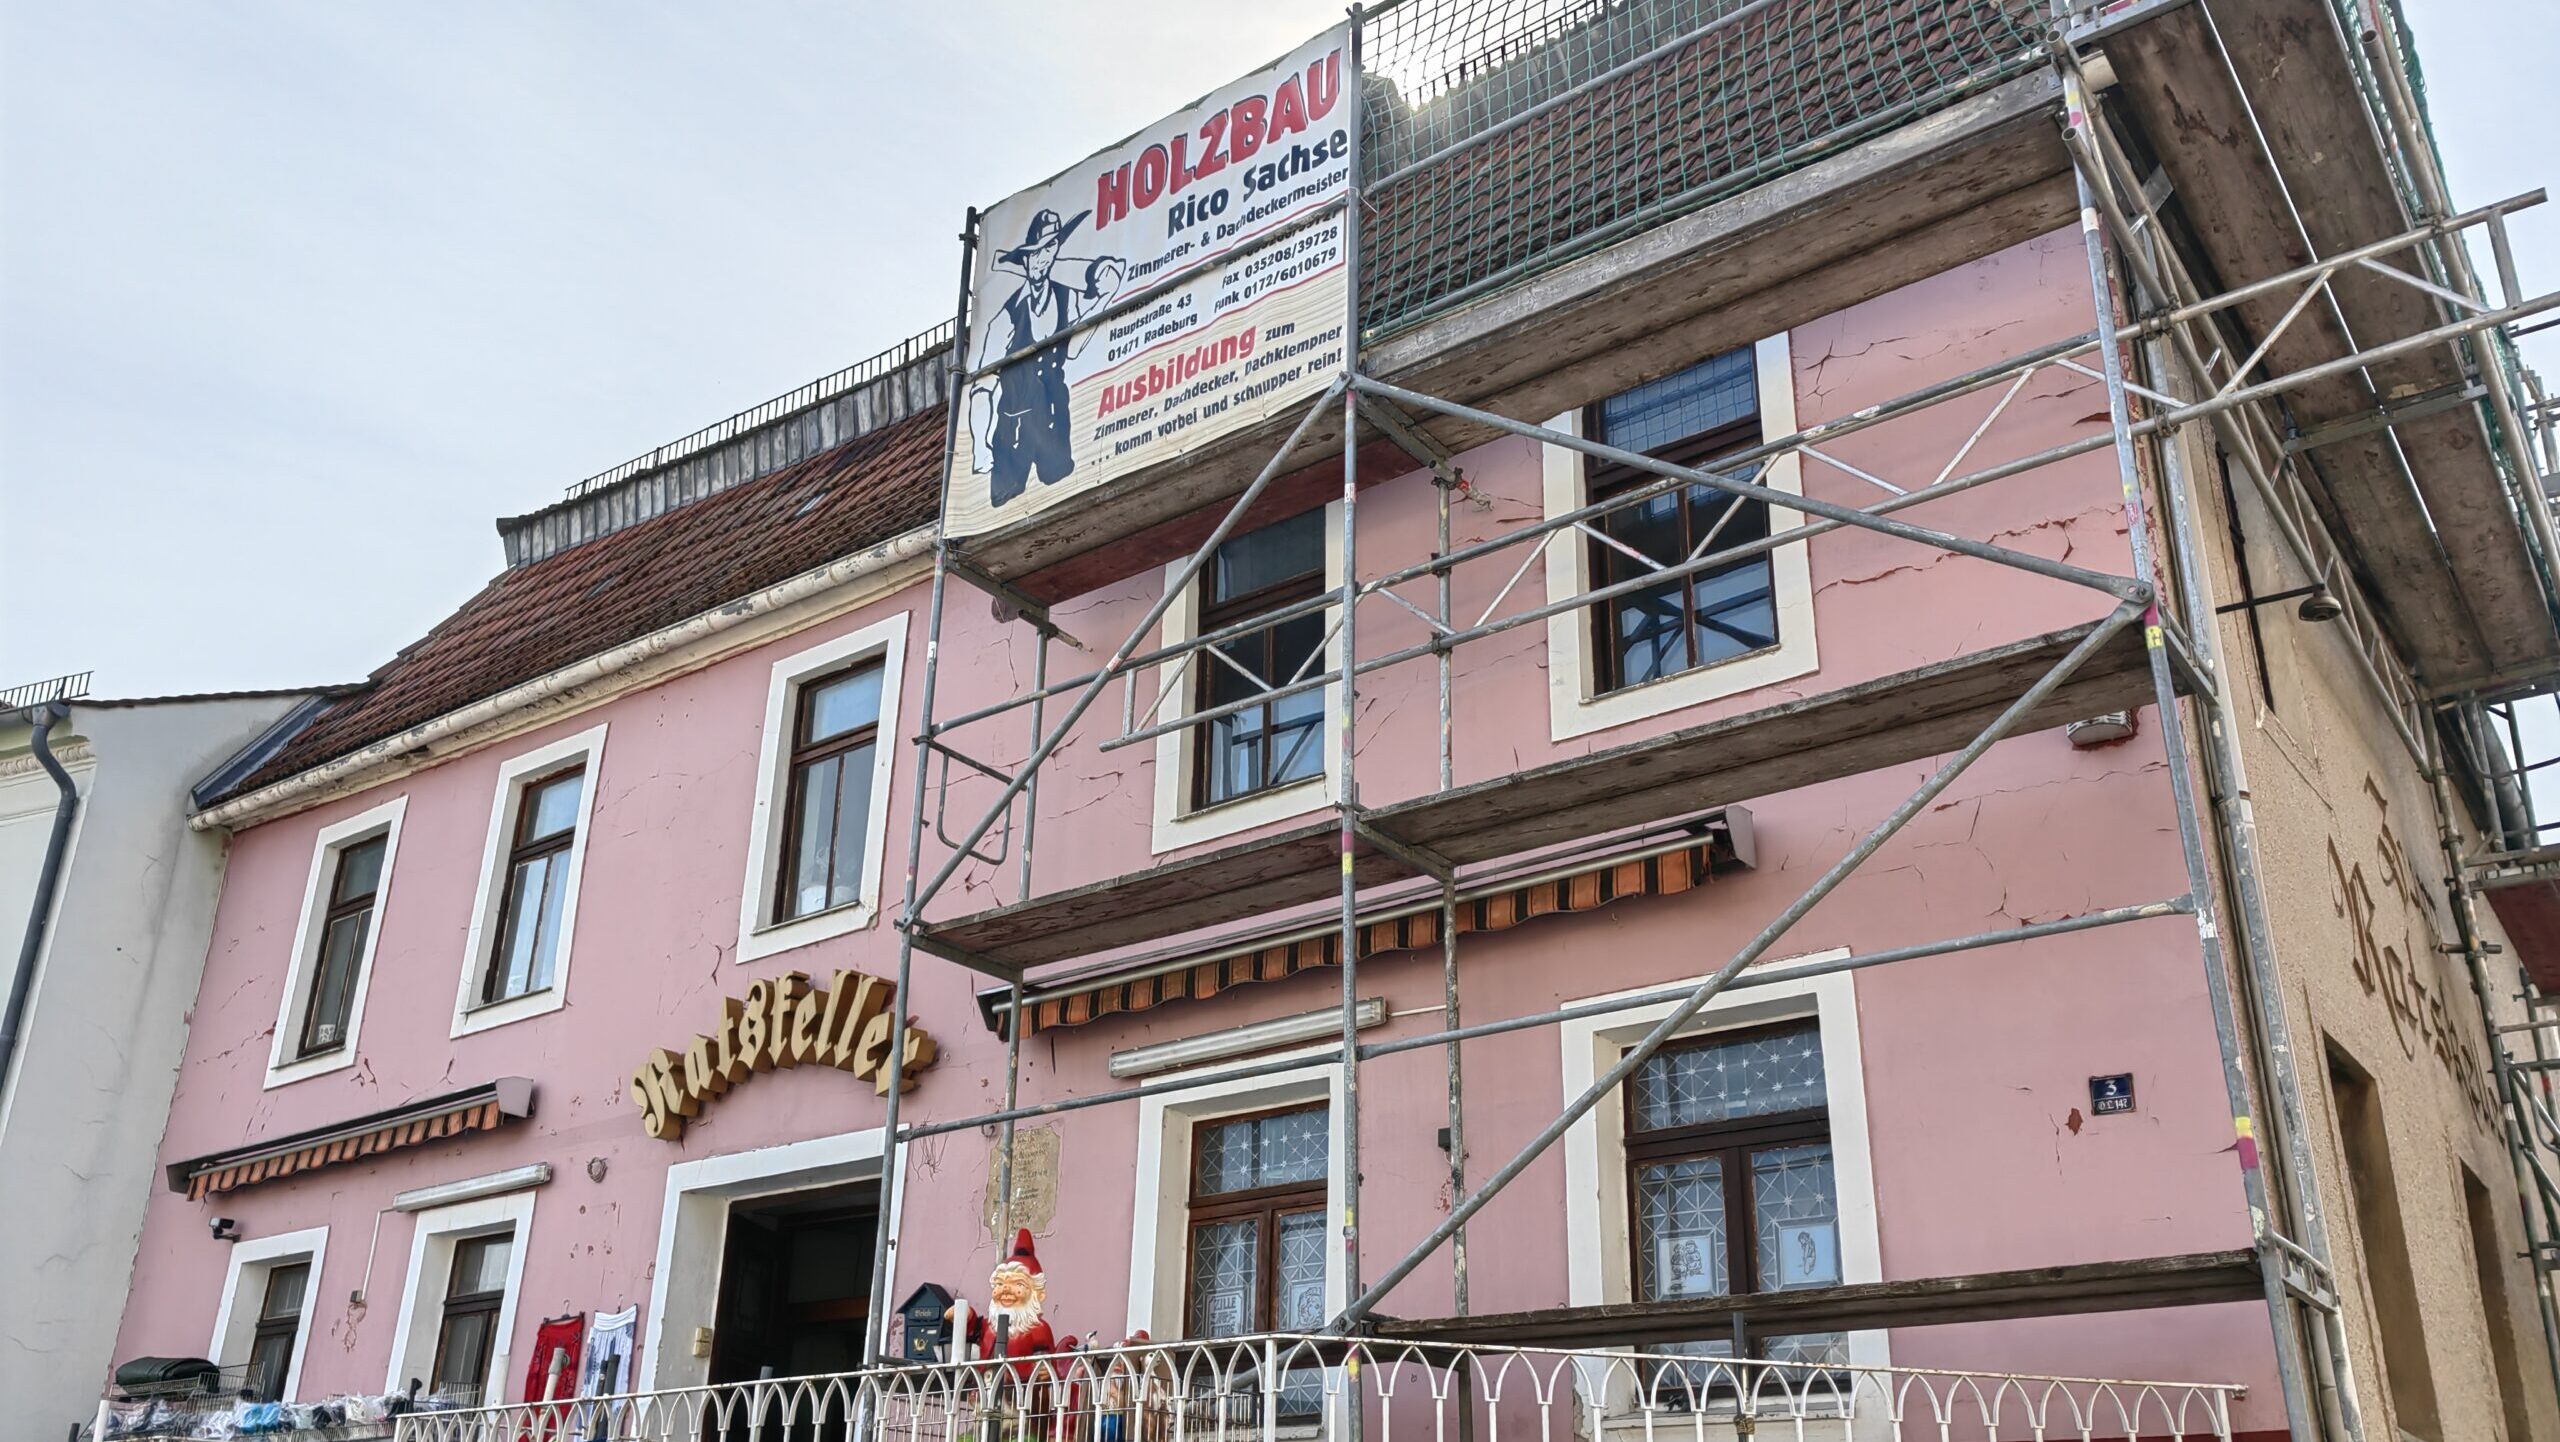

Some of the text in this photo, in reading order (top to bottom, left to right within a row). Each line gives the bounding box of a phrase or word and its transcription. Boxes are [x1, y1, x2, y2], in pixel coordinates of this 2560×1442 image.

[1096, 47, 1342, 231] HOLZBAU
[1168, 188, 1229, 239] Rico
[1243, 129, 1348, 203] Sachse
[1127, 243, 1195, 282] Zimmerer-
[1200, 233, 1210, 247] &
[1244, 247, 1337, 299] 0172/6010679
[1245, 226, 1338, 278] 035208/39728
[1108, 313, 1197, 361] 01471 Radeburg
[1109, 303, 1172, 341] Hauptstraße
[1177, 293, 1192, 309] 43
[1094, 324, 1342, 441] Zimmerer, Dachdecker, Dachklempner
[1097, 321, 1295, 419] Ausbildung zum
[1114, 430, 1153, 456] komm
[1157, 409, 1197, 437] vorbei
[1203, 396, 1228, 420] und
[1233, 365, 1301, 409] schnupper
[1307, 347, 1342, 374] rein!
[2105, 1080, 2117, 1096] 3
